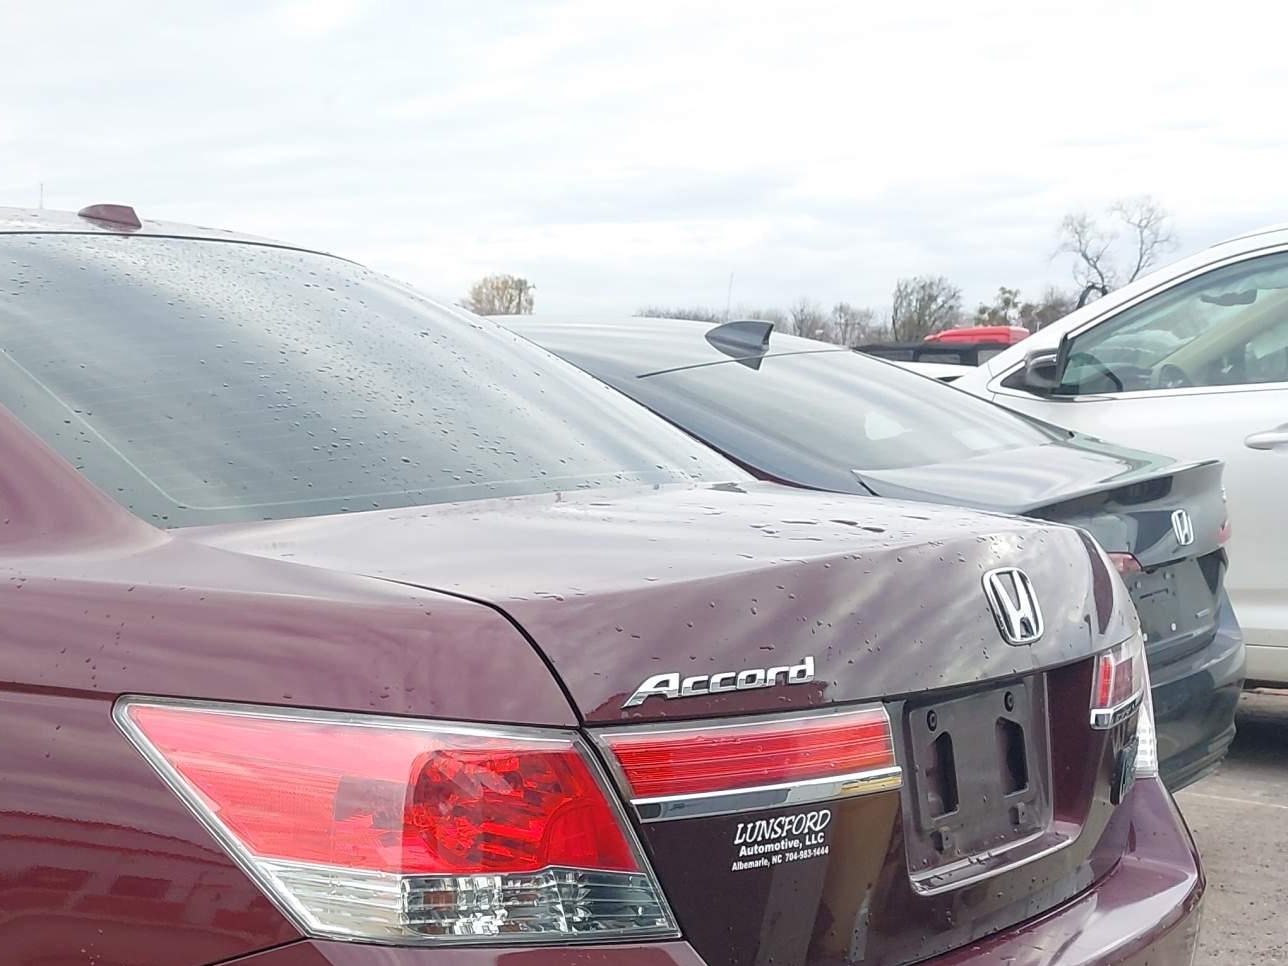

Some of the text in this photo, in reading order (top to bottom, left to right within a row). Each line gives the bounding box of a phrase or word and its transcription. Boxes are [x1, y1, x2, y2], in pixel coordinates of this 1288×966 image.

[621, 656, 814, 708] Accord
[734, 810, 831, 845] LUNSFORD
[731, 846, 830, 872] Albemarle, NC 704-983-1444
[739, 833, 825, 857] Automotive, LLC
